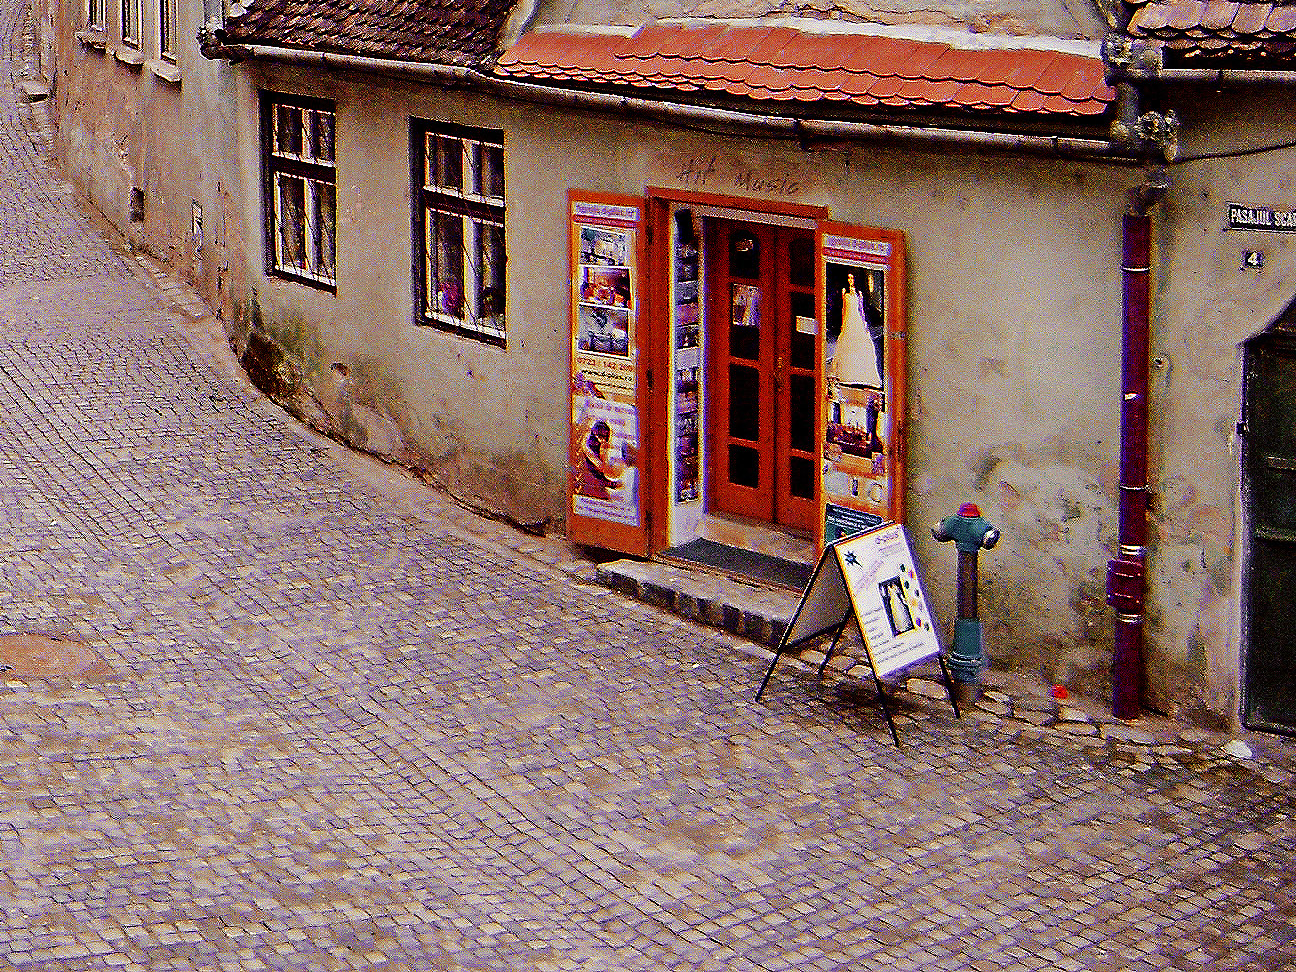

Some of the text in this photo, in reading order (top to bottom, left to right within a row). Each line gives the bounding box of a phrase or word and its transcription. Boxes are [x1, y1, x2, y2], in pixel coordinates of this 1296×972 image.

[735, 169, 800, 196] Music
[1231, 209, 1272, 225] PASAJUL
[1247, 252, 1258, 266] 4
